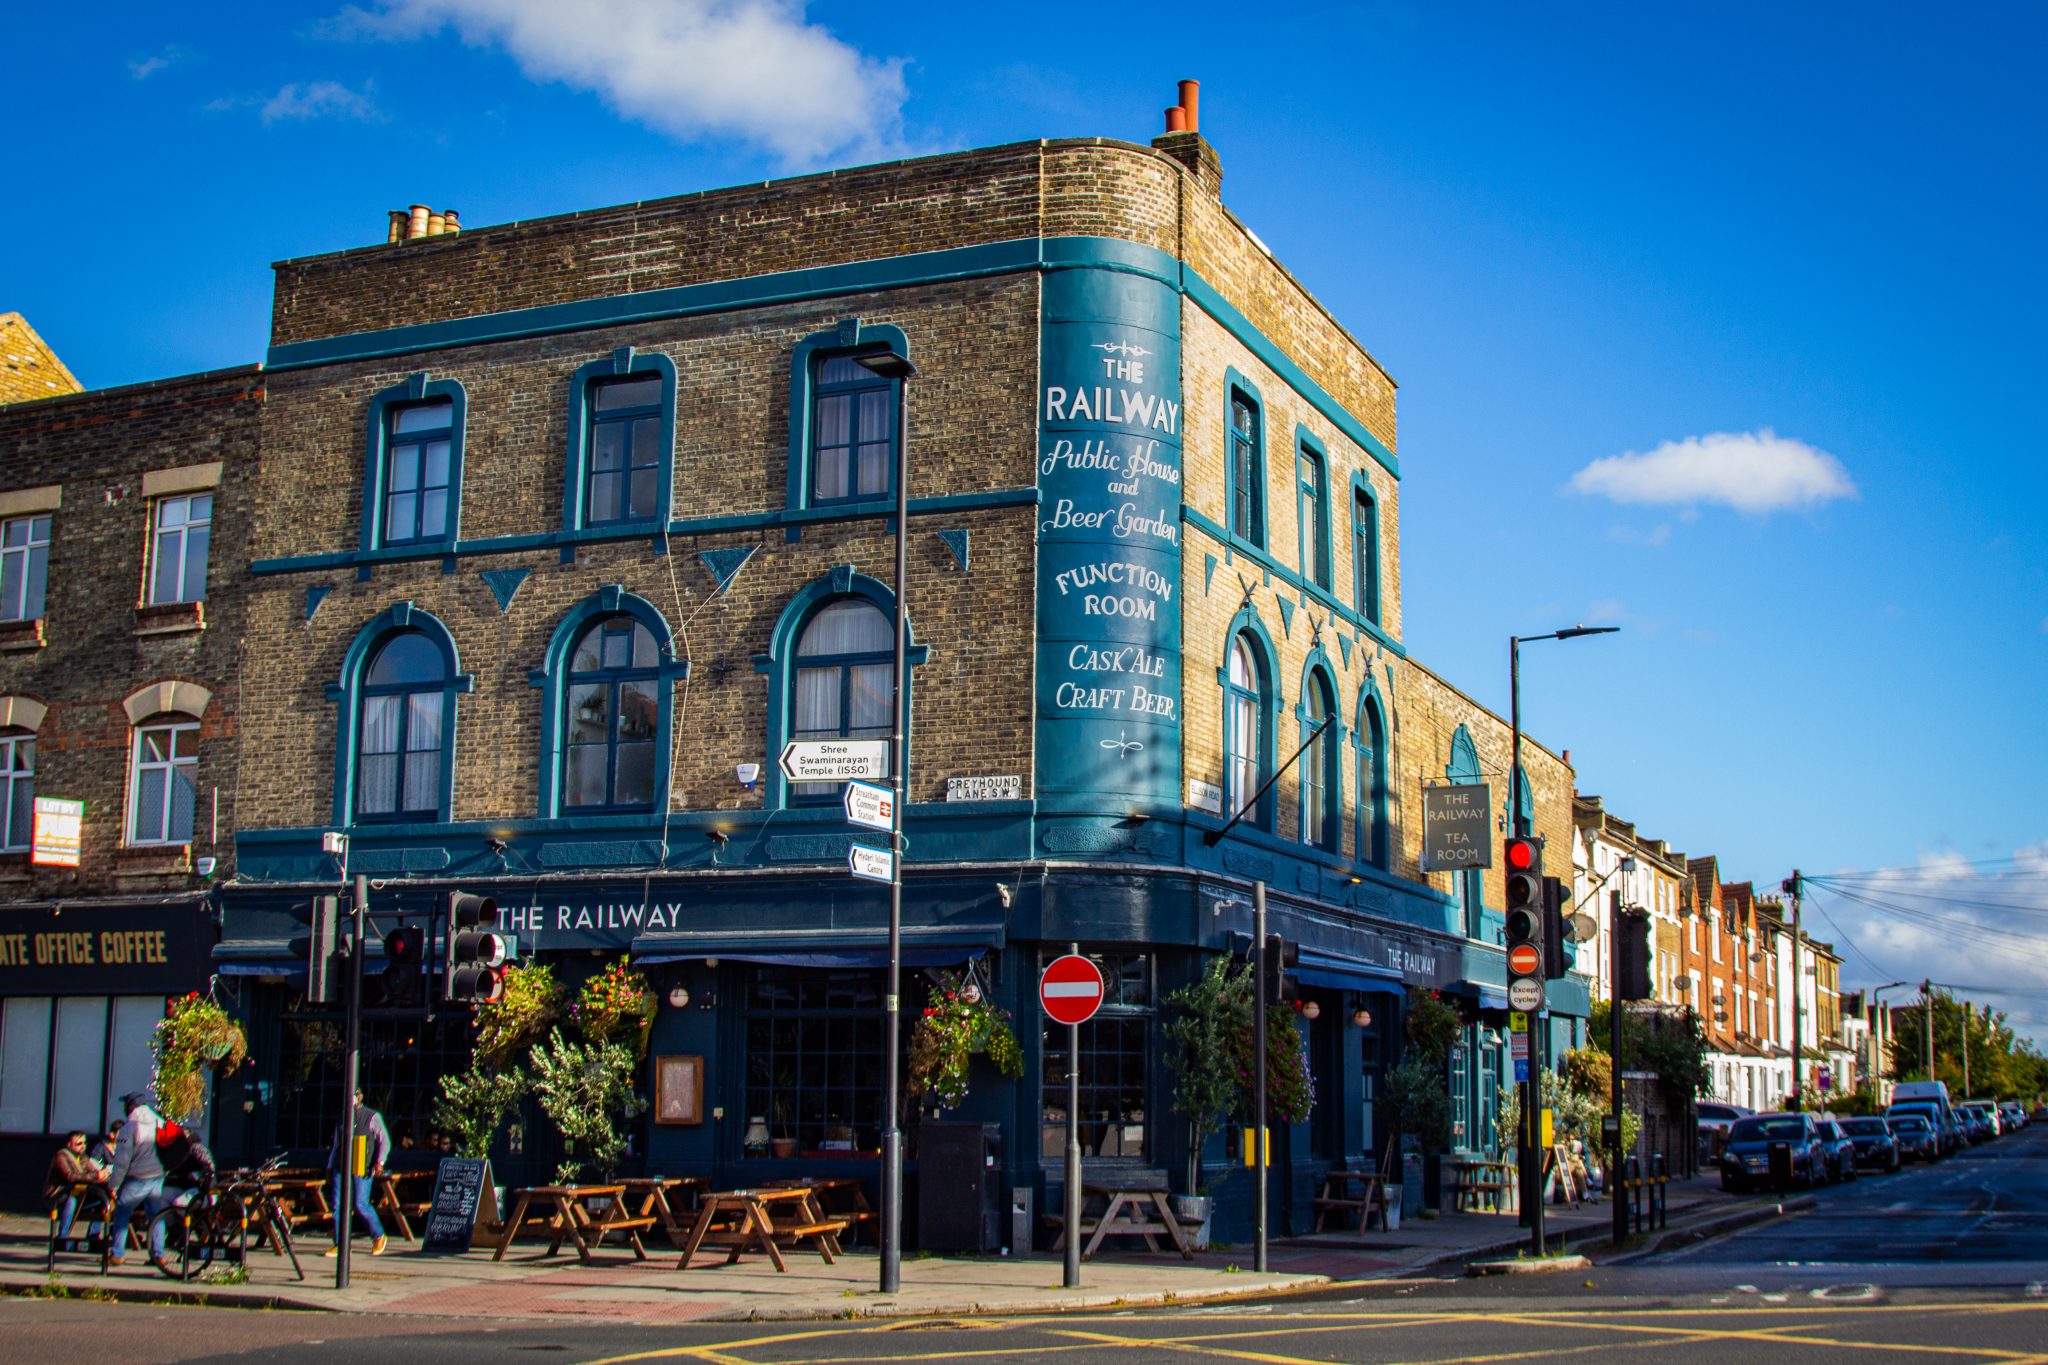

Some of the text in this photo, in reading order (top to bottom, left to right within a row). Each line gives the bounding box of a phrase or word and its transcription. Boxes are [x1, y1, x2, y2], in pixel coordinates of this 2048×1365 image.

[1102, 358, 1144, 384] THE
[1046, 386, 1179, 435] RAILWAY
[1041, 440, 1179, 484] Public House
[1107, 478, 1139, 495] and
[1041, 499, 1178, 547] Beer Garden
[1055, 562, 1172, 602] FUNCTION
[1084, 595, 1156, 621] ROOM
[1068, 644, 1165, 677] CASK ALE
[1056, 682, 1176, 721] CRAFT BEER
[820, 745, 848, 754] Shree
[799, 756, 869, 765] Swaminarayan
[799, 764, 869, 776] Temple (ISSO)
[856, 798, 878, 811] Common
[1443, 793, 1469, 805] THE
[858, 810, 875, 821] Station
[1428, 808, 1485, 821] RAILWAY
[1445, 832, 1470, 844] TEA
[1437, 848, 1478, 861] ROOM
[496, 903, 682, 931] THE RAILWAY
[35, 932, 94, 965] OFFICE
[100, 931, 167, 964] COFFEE
[1388, 948, 1436, 977] THE RAILWAY
[1512, 986, 1538, 994] Except
